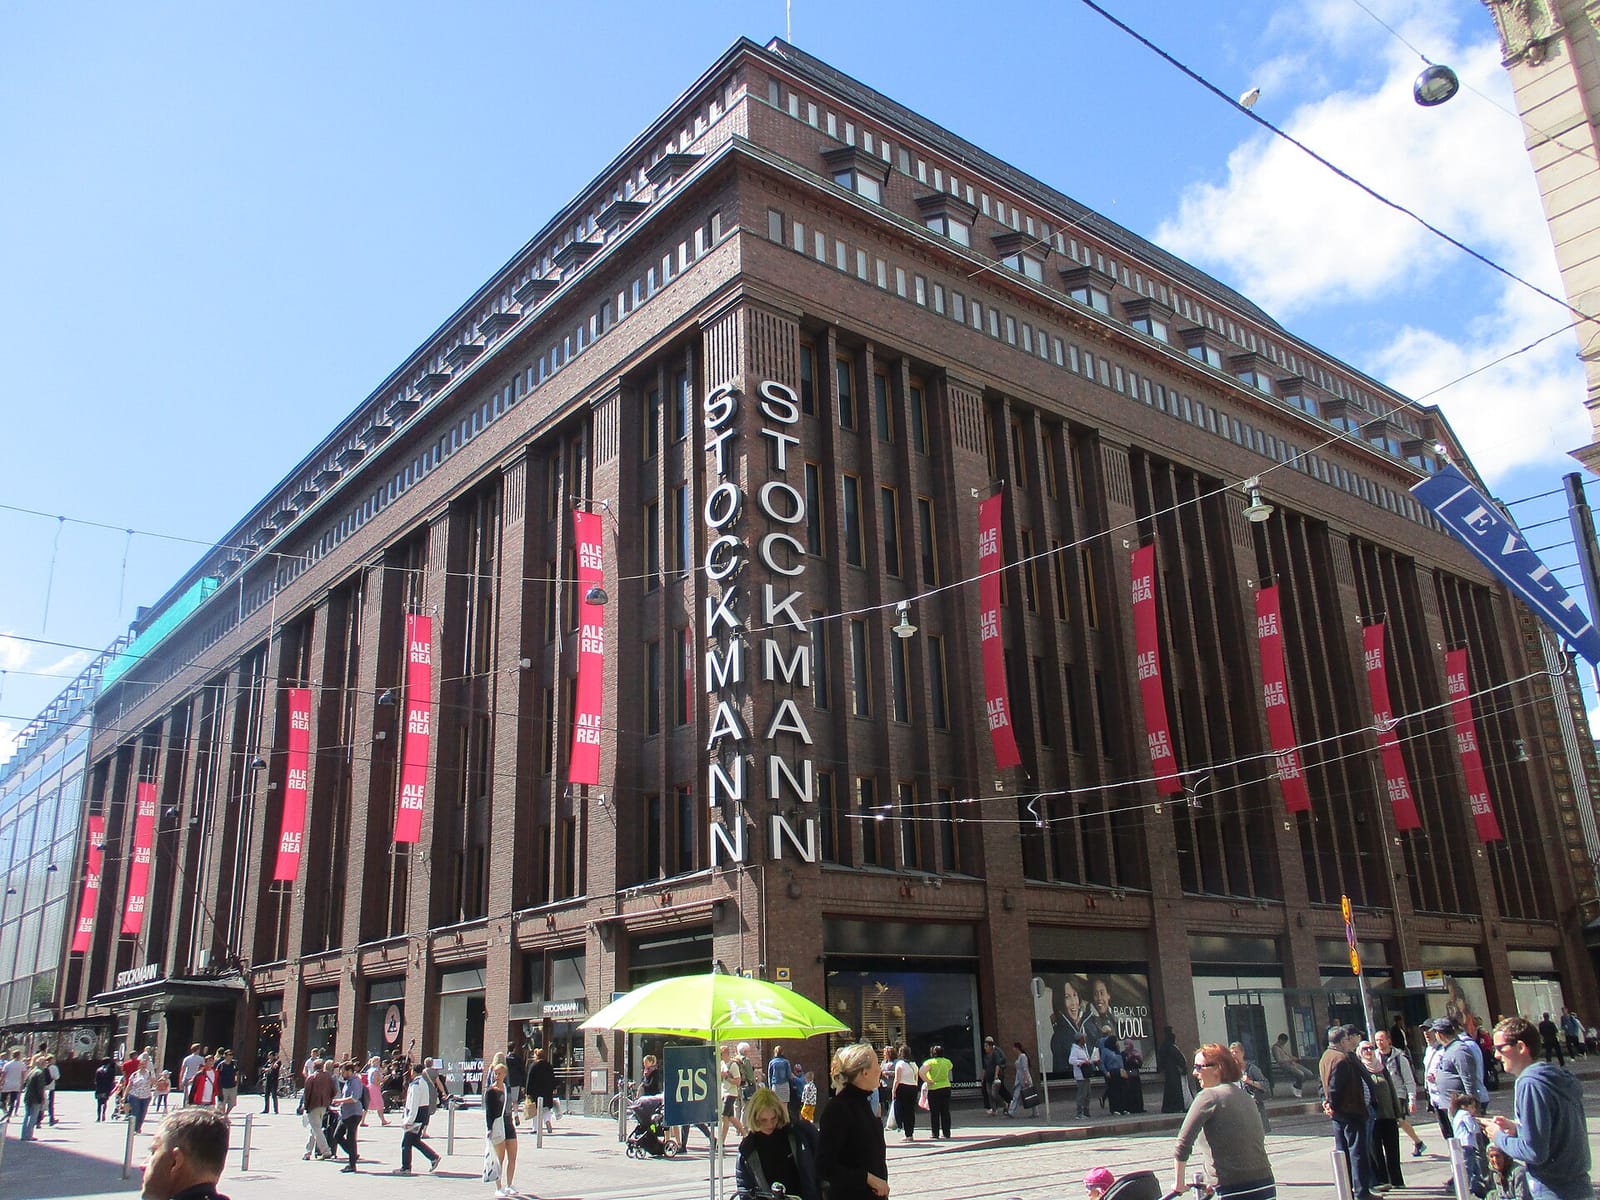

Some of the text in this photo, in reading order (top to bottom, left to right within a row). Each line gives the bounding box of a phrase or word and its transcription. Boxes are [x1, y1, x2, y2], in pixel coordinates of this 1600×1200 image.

[580, 542, 602, 557] ALE
[580, 555, 603, 570] REA
[1132, 576, 1150, 592] ALE
[1132, 588, 1152, 604] REA
[704, 382, 744, 866] STOCKMANN
[756, 380, 816, 864] STOCKMANN
[1257, 613, 1276, 628] ALE
[582, 624, 604, 640] ALE
[1258, 624, 1278, 639] REA
[410, 641, 431, 653] ALE
[582, 640, 604, 655] REA
[410, 652, 431, 665] REA
[1137, 651, 1155, 668] ALE
[1138, 663, 1158, 680] REA
[1264, 682, 1283, 696] ALE
[1264, 693, 1286, 708] REA
[291, 710, 310, 720] ALE
[409, 710, 430, 722] ALE
[578, 713, 600, 728] ALE
[291, 720, 310, 730] REA
[408, 722, 430, 735] REA
[576, 728, 600, 744] REA
[1148, 730, 1167, 748] ALE
[1150, 744, 1171, 760] REA
[288, 769, 306, 780] ALE
[288, 780, 307, 790] REA
[402, 784, 424, 798] ALE
[1387, 778, 1406, 791] ALE
[1389, 789, 1410, 802] REA
[400, 797, 423, 810] REA
[282, 832, 301, 843] ALE
[280, 842, 300, 853] REA
[115, 963, 158, 989] STOCKMANN
[726, 998, 784, 1026] HS
[1114, 1006, 1147, 1017] BACK TO
[1118, 1017, 1148, 1040] COOL
[676, 1068, 708, 1103] HS
